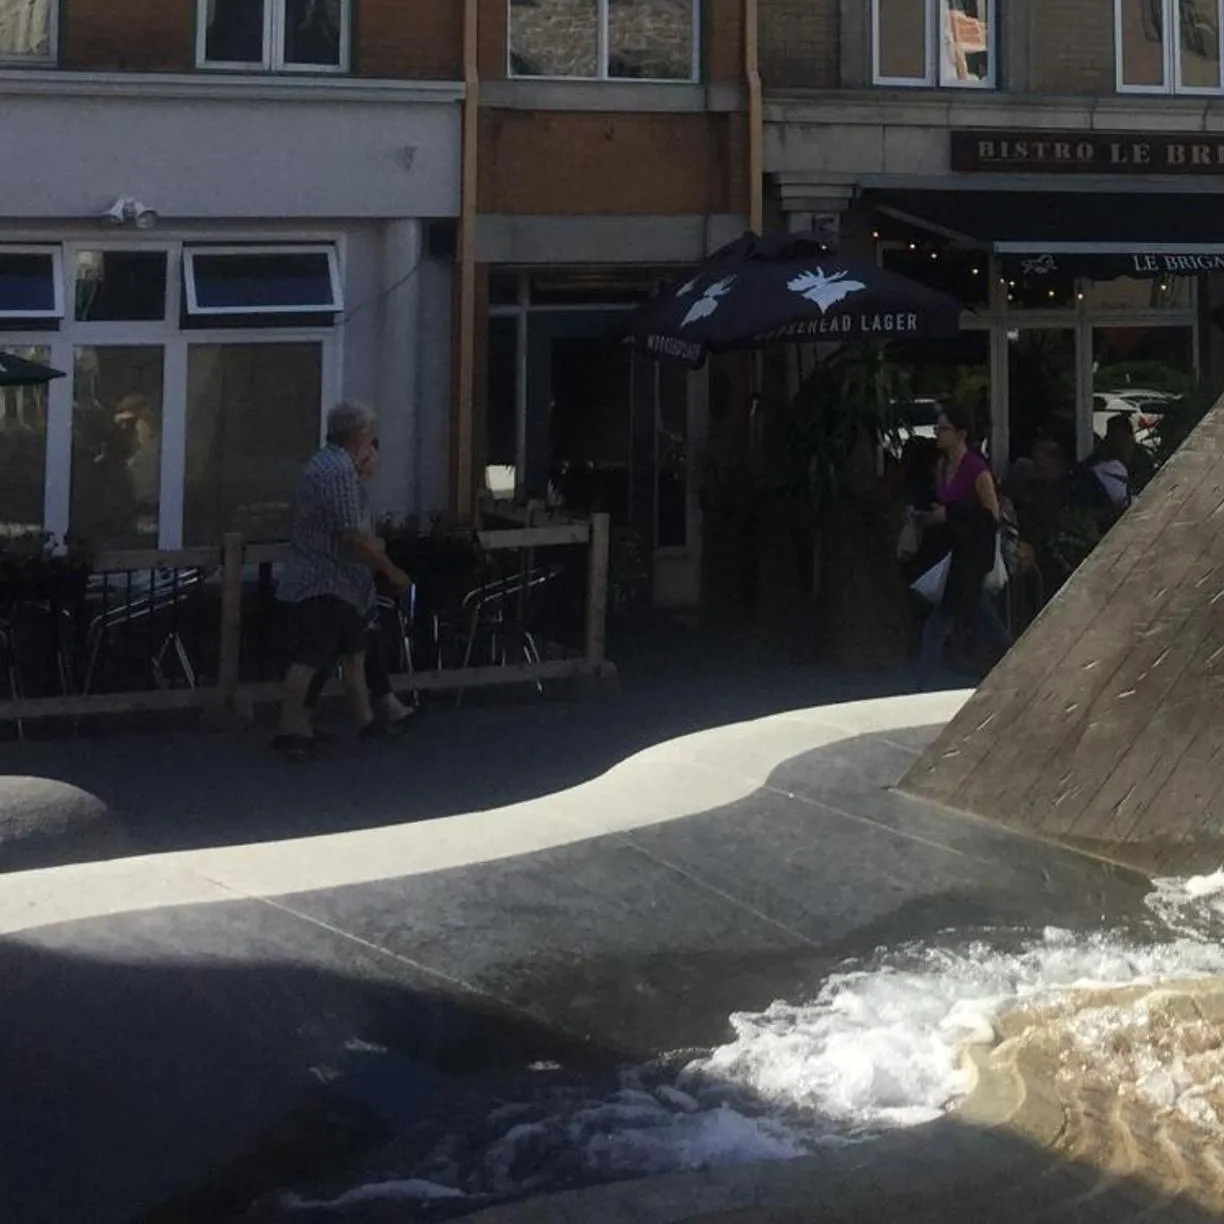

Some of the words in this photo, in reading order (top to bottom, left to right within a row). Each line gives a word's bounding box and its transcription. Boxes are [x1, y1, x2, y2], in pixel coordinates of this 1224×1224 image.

[978, 140, 1094, 160] BISTRO
[1110, 142, 1150, 165] LE
[1133, 254, 1159, 272] LE
[860, 313, 918, 331] LAGER
